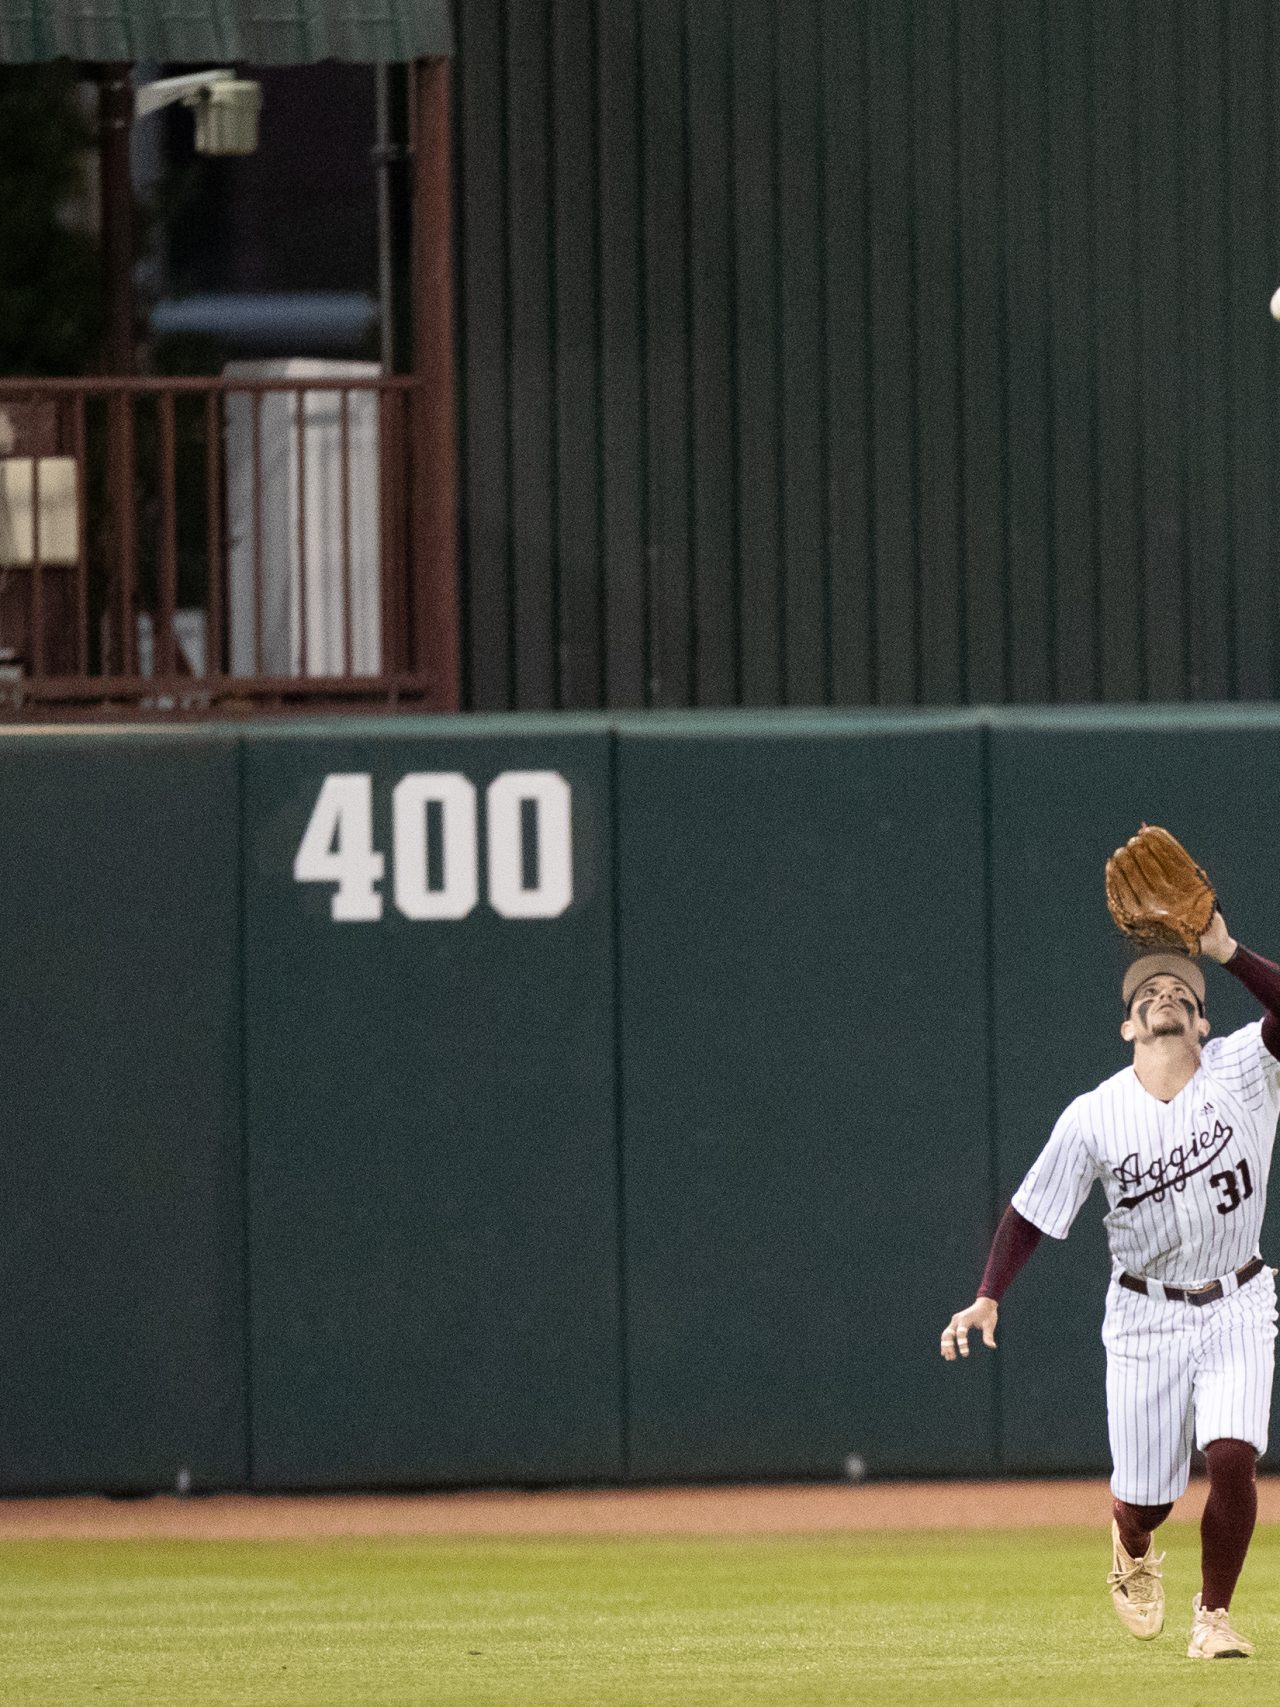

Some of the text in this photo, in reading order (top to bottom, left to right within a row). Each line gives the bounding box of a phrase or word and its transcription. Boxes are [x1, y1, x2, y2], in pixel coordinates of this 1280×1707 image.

[293, 770, 573, 922] 400
[1112, 1119, 1234, 1203] Aggies
[1209, 1158, 1254, 1215] 31
